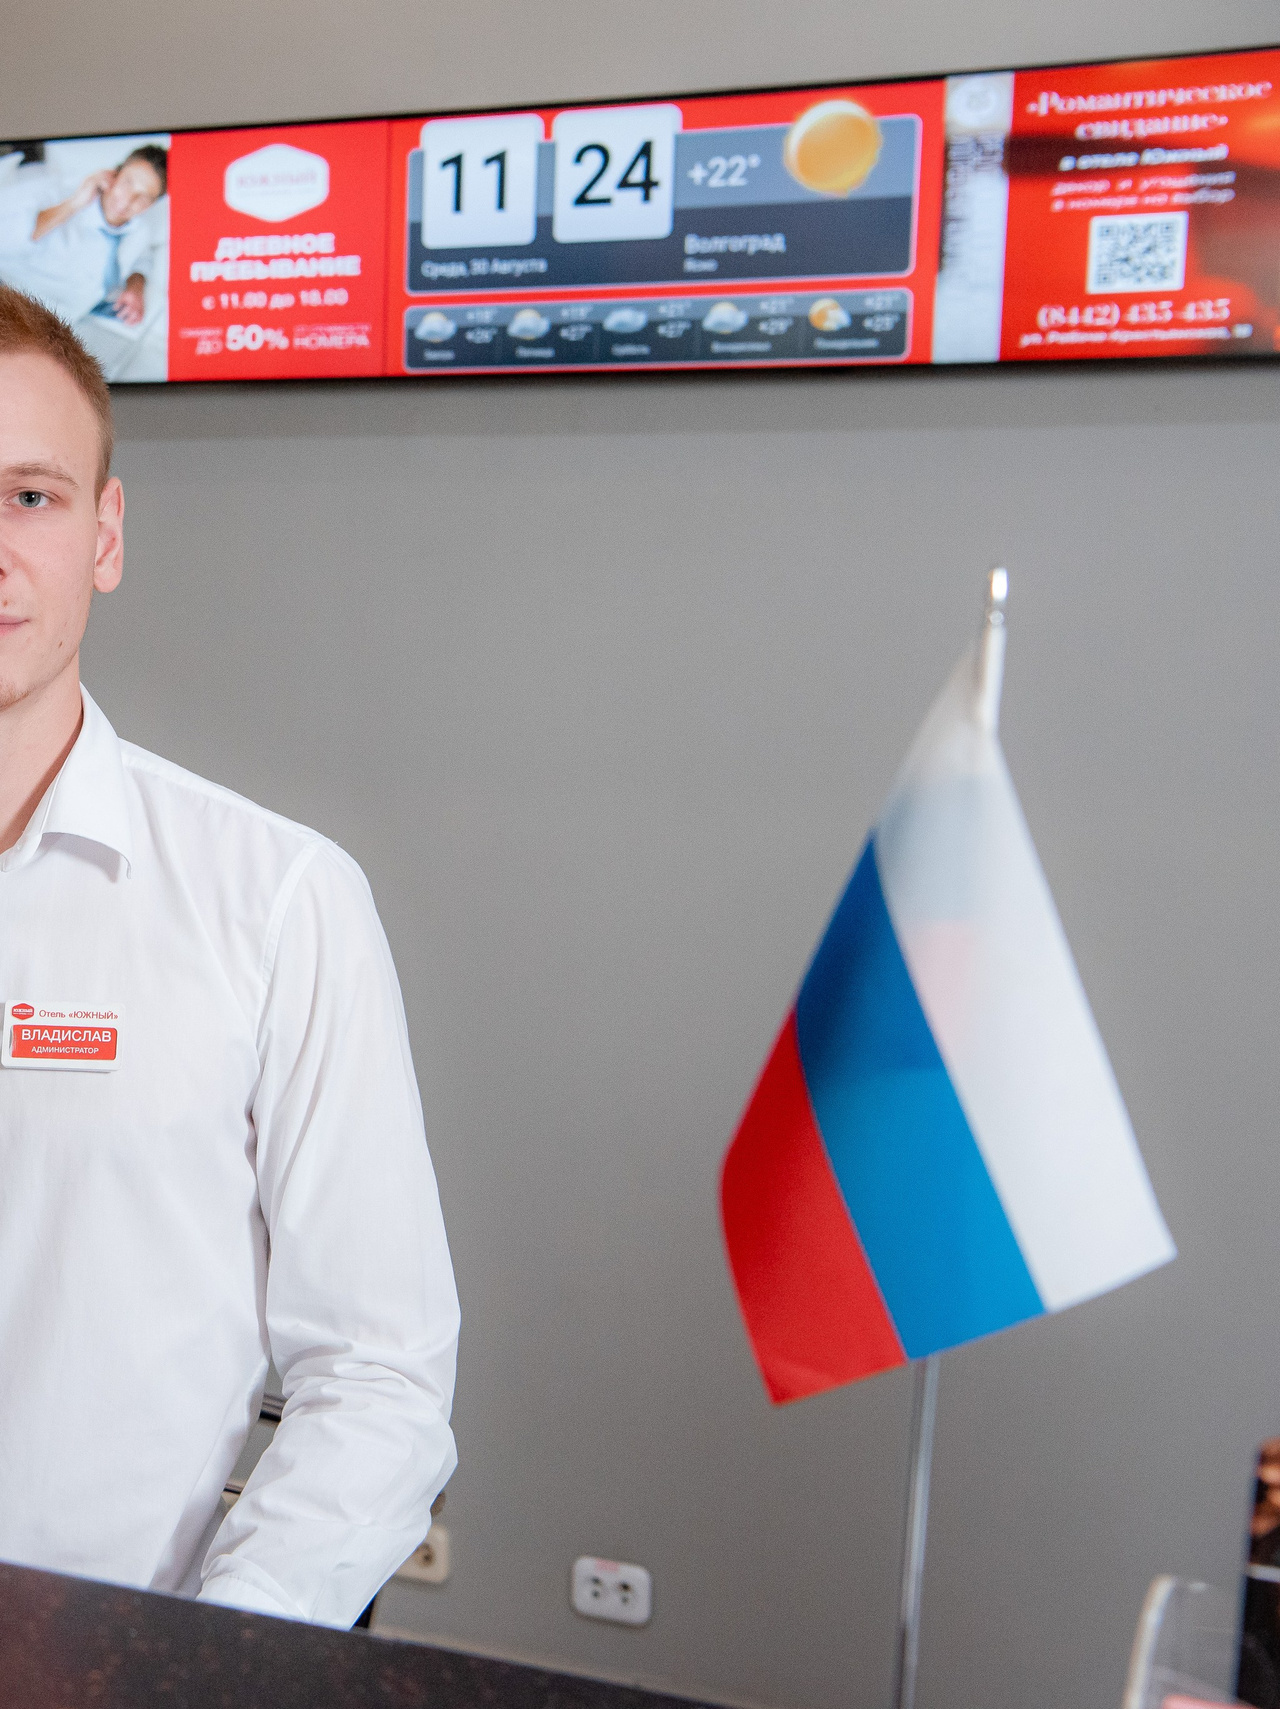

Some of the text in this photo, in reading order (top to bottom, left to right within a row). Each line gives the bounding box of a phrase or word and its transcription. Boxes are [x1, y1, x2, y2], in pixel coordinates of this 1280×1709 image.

[439, 150, 508, 214] 11
[573, 139, 660, 207] 24
[688, 153, 760, 188] +22°
[215, 233, 335, 260] ДНЕВНОЕ
[684, 233, 786, 255] Волгоград
[190, 255, 361, 281] ПРЕБЫВАНИЕ
[226, 324, 289, 350] 50%
[39, 1010, 65, 1018] Отель
[68, 1011, 118, 1019] «ЮЖНЫЙ»
[21, 1029, 112, 1043] ВЛАДИСЛАВ
[31, 1046, 99, 1054] АДМИНИСТРАТОР
